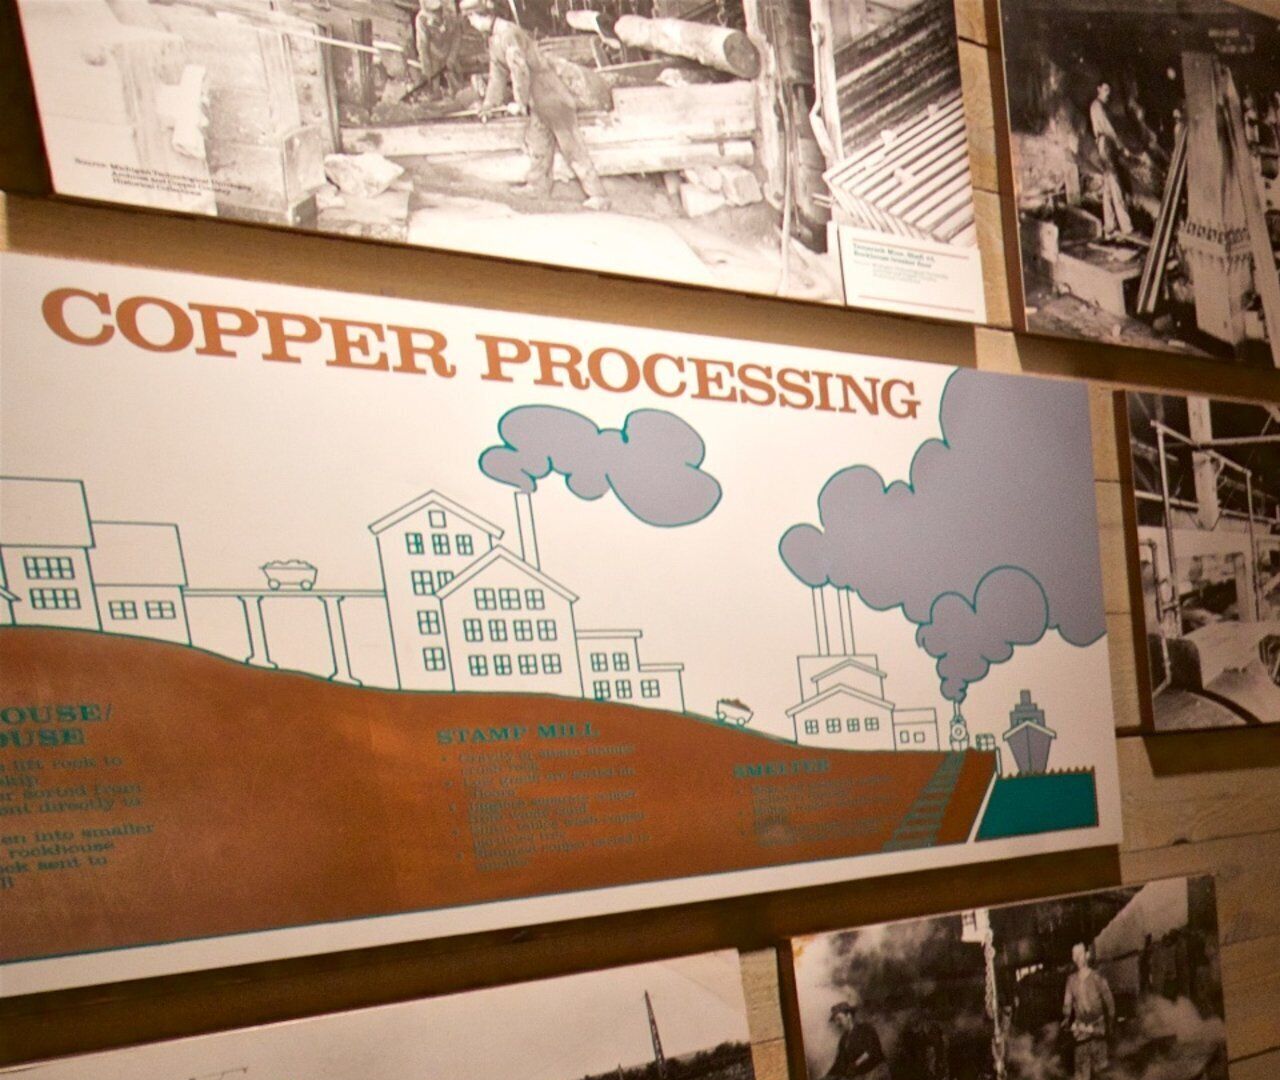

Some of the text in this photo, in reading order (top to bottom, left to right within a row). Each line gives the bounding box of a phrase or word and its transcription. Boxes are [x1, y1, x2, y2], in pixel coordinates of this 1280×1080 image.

[42, 285, 923, 420] COPPER PROCESSING
[435, 721, 600, 745] STAMP MILL
